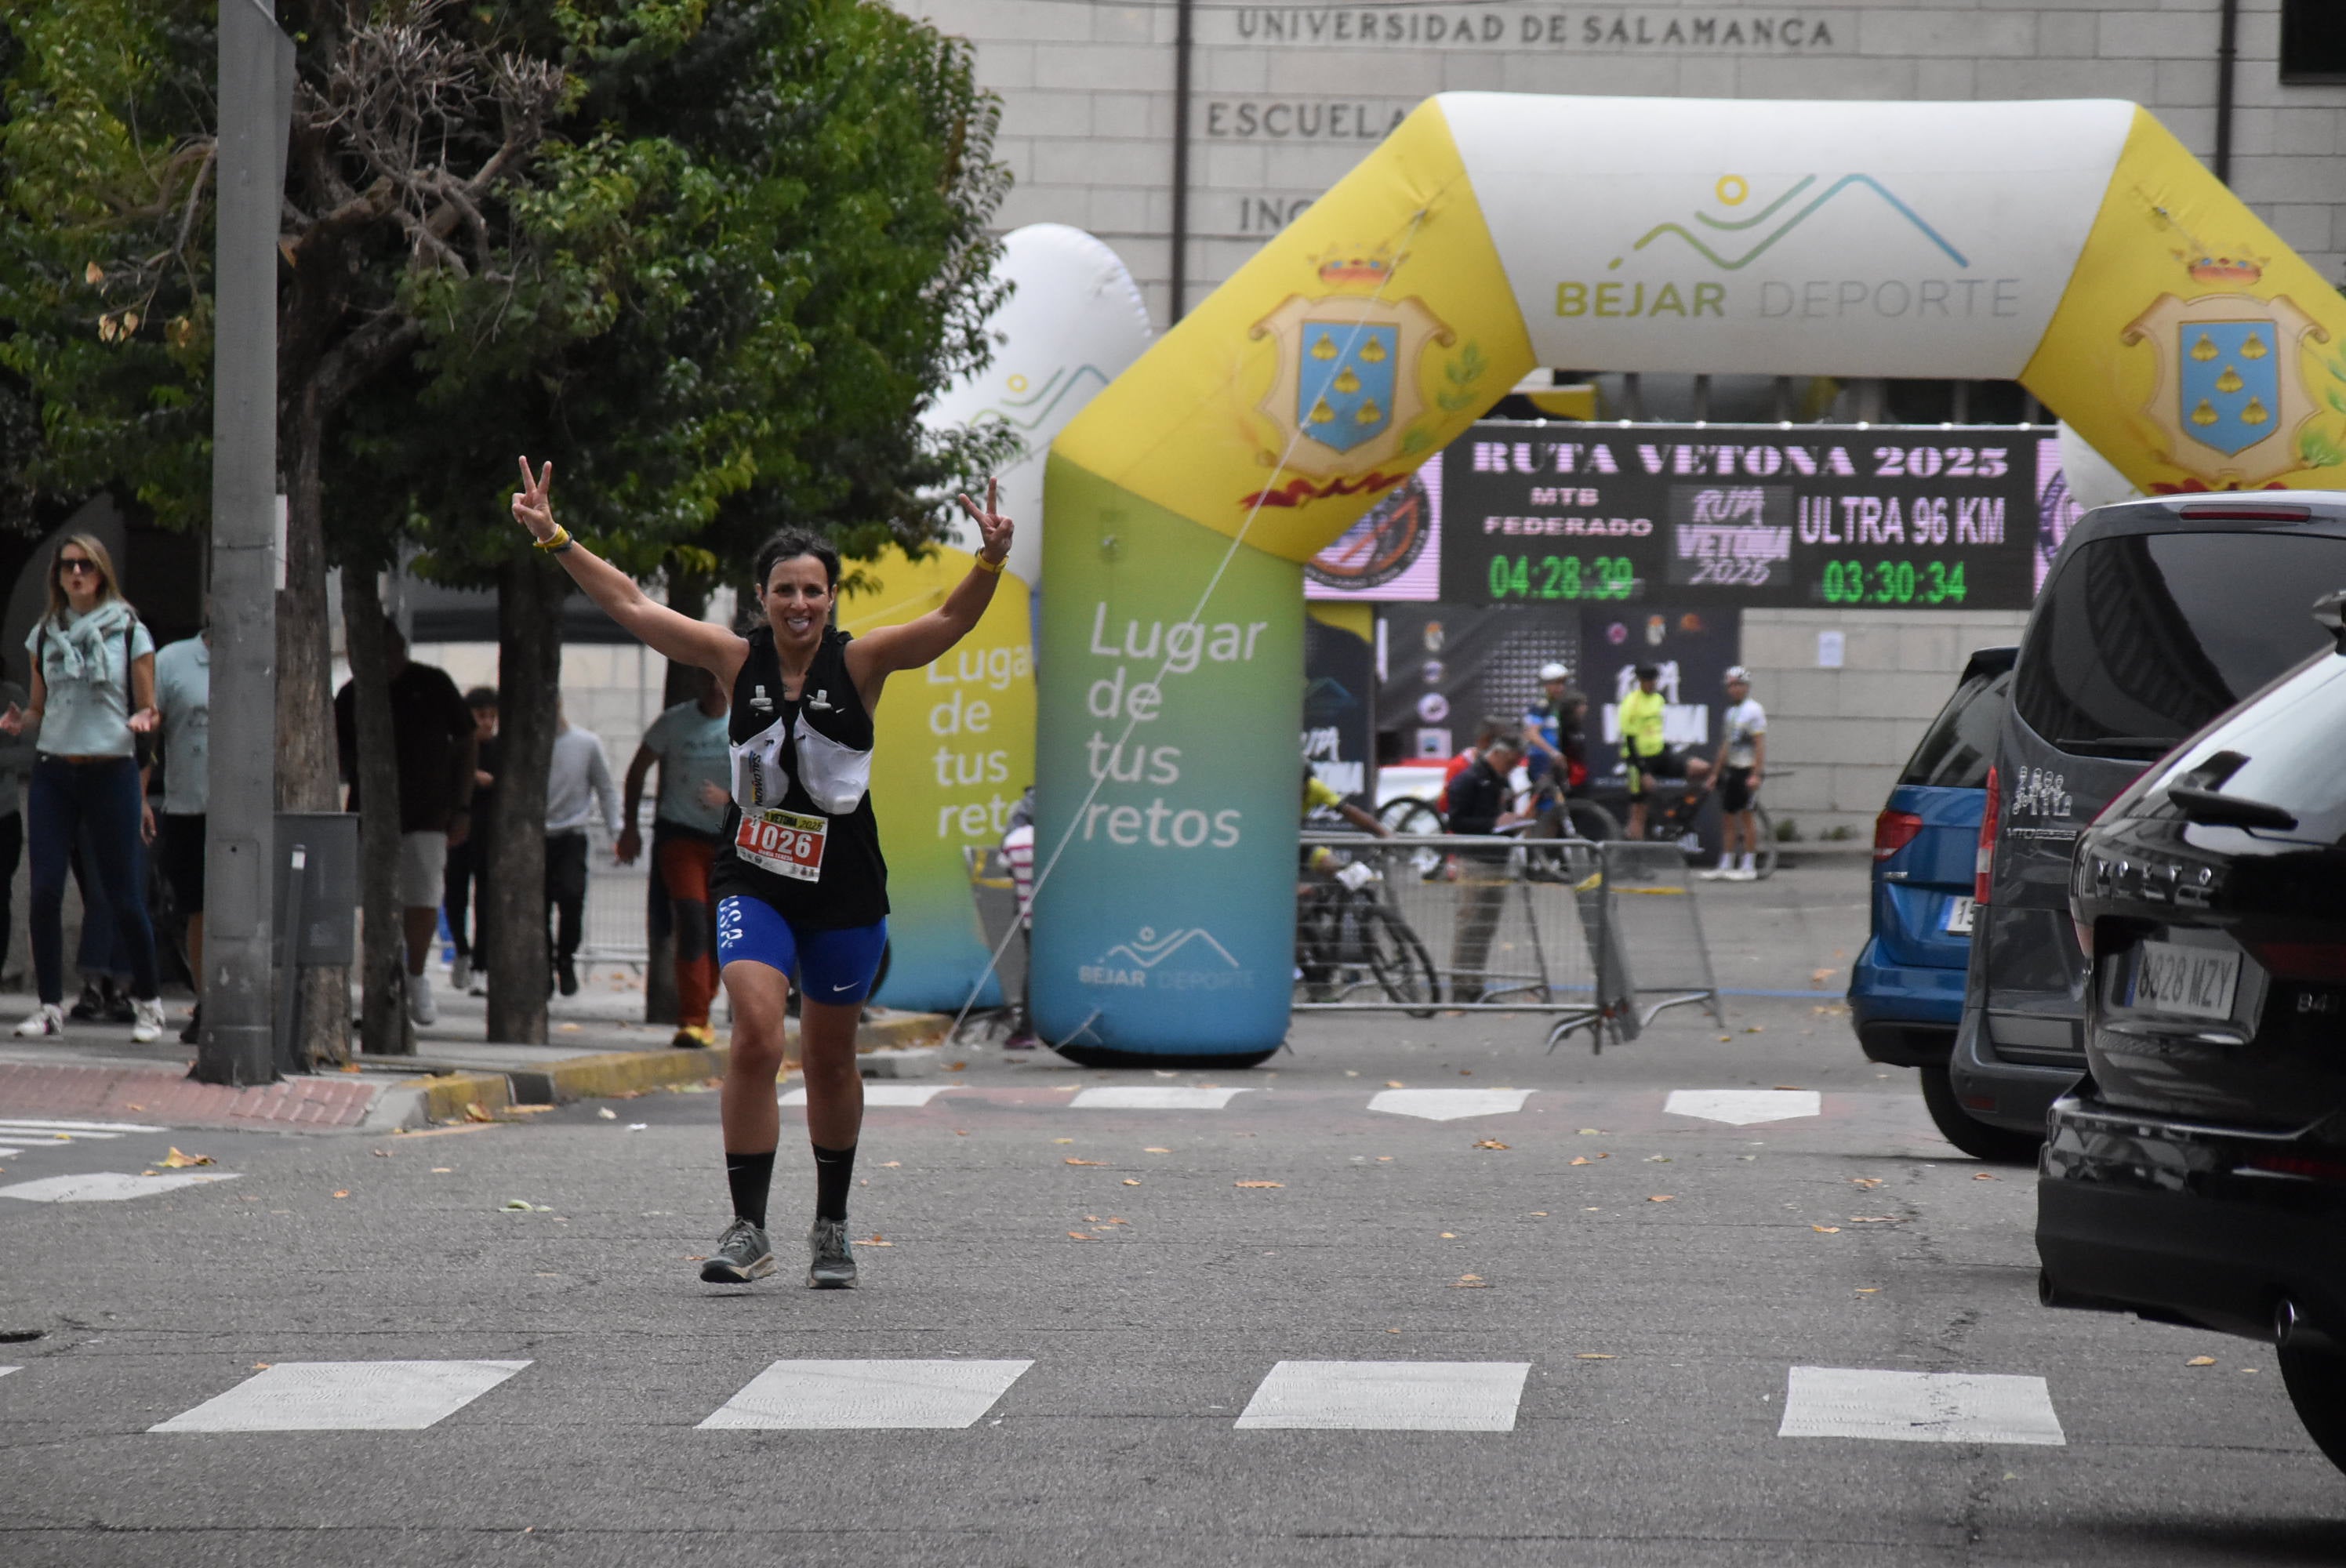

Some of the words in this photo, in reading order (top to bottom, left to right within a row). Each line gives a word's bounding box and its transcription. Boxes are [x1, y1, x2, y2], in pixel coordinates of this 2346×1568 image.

[1237, 12, 1505, 43] UNIVERSIDAD
[1521, 14, 1567, 45] DE
[1582, 15, 1834, 47] SALAMANCA
[1761, 279, 2021, 318] DEPORTE
[1474, 441, 1620, 474] RUTA
[1637, 443, 1856, 477] VETONA
[1873, 445, 2009, 477] 2025
[1531, 487, 1600, 506] MTB
[1483, 516, 1654, 536] FEDERADO
[1799, 495, 1905, 545] ULTRA
[1911, 496, 1949, 545] 96
[1955, 496, 2006, 545] KM
[1822, 560, 1968, 603] 03:30:34
[1090, 601, 1268, 673] Lugar
[929, 689, 991, 735] de
[1088, 666, 1163, 721] de
[932, 746, 1008, 786] tus
[1085, 731, 1182, 785] tus
[749, 818, 813, 858] 1026
[1083, 797, 1242, 848] retos
